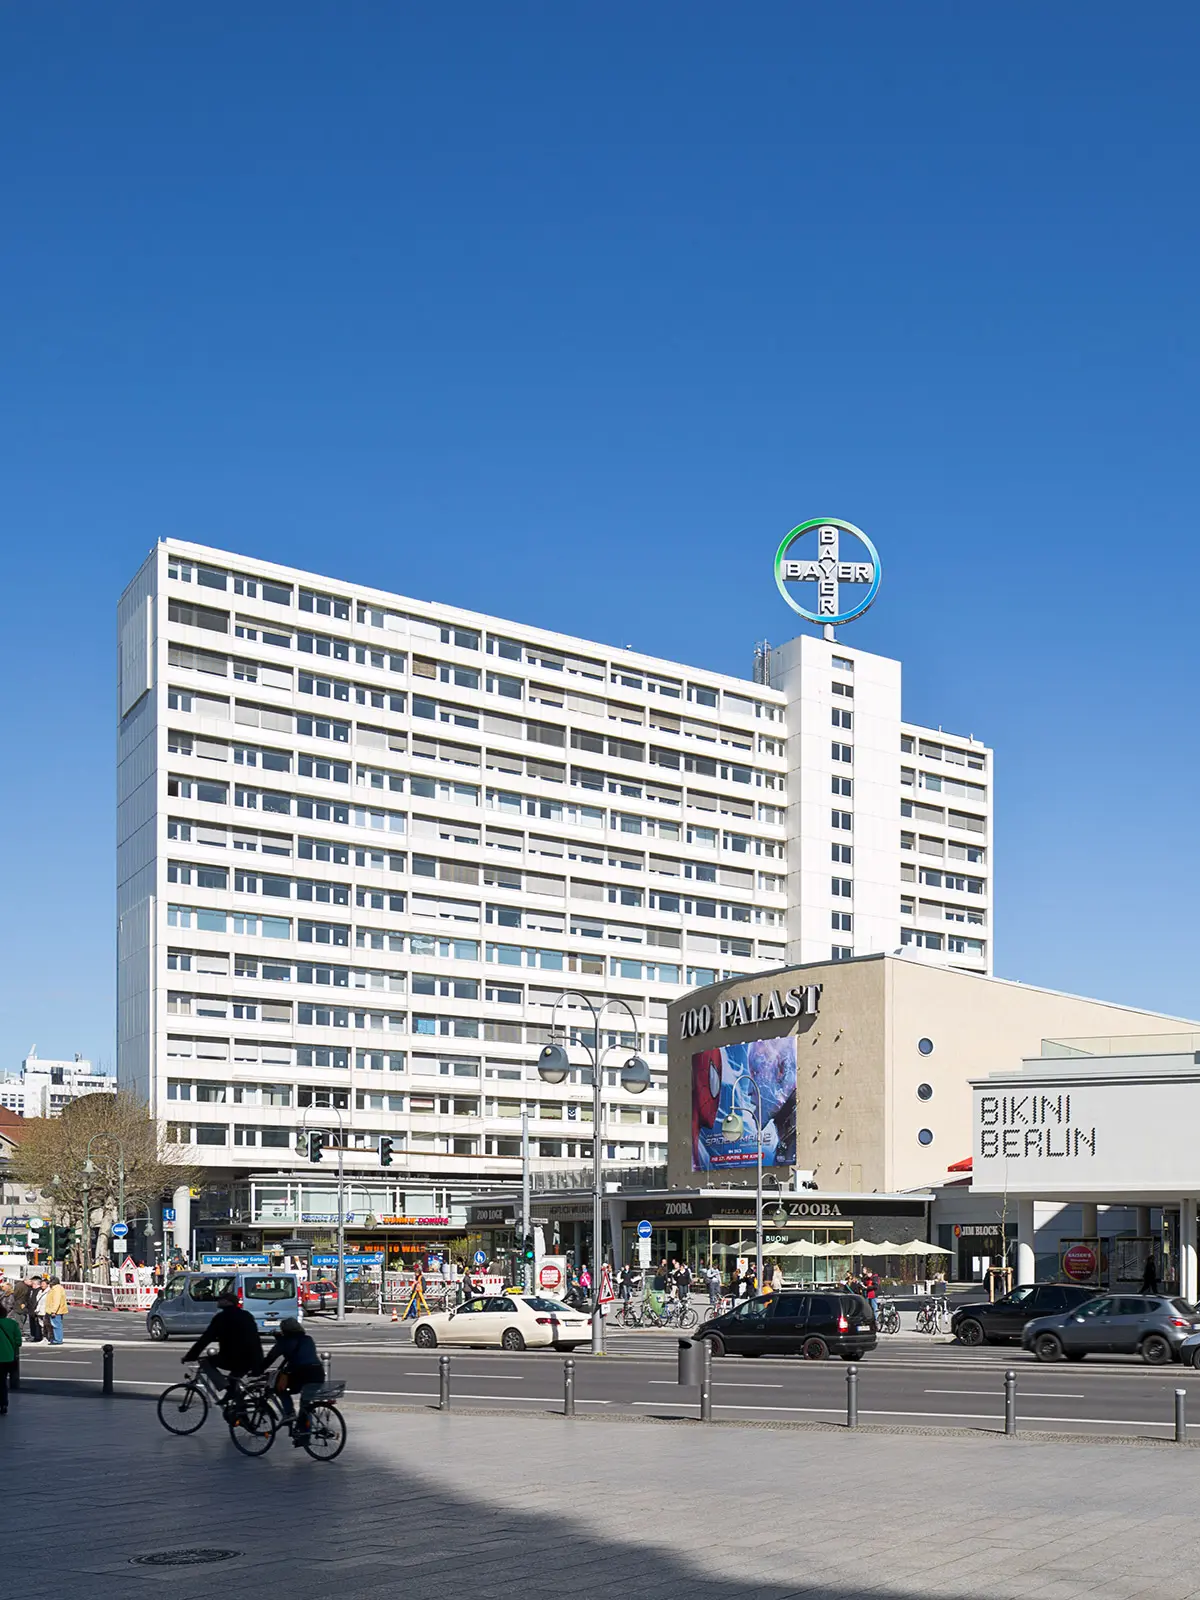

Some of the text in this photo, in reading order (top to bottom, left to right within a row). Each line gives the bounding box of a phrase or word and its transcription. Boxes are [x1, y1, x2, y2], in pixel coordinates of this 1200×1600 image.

[786, 563, 870, 579] BAYER
[820, 530, 836, 614] BAYER
[680, 984, 822, 1040] ZOO PALAST
[981, 1094, 1070, 1126] BIKINI
[981, 1127, 1096, 1158] BERLIN
[665, 1203, 693, 1215] ZOOBA
[788, 1203, 842, 1216] ZOOBA
[961, 1225, 999, 1236] JIM BLOCK
